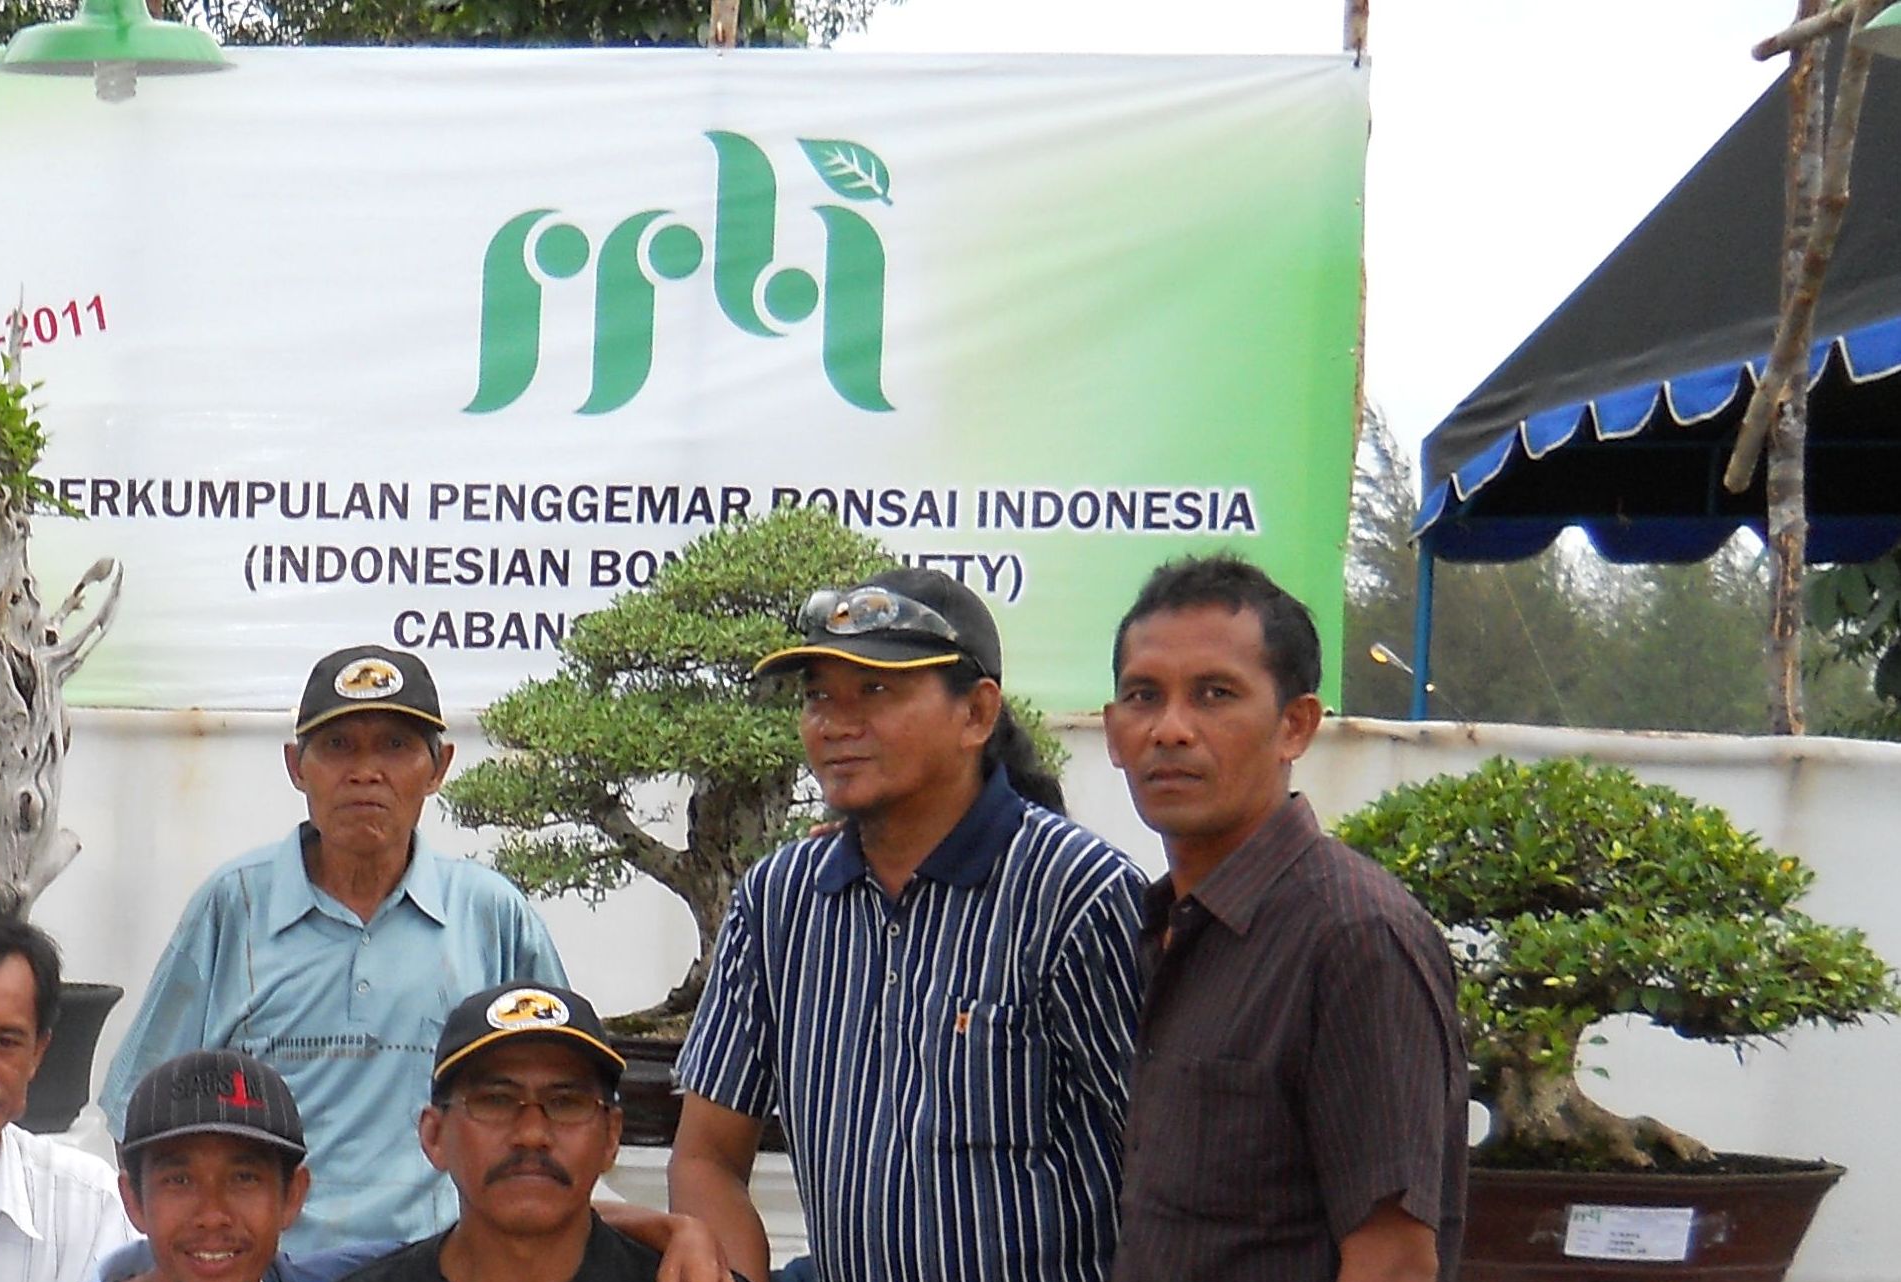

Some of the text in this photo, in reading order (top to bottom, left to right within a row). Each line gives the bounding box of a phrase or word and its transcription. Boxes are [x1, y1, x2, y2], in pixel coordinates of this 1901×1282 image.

[27, 478, 409, 520] PERKUMPULAN
[429, 482, 752, 525] PENGGEMAR
[978, 490, 1256, 531] INDONESIA
[244, 545, 570, 591] (INDONESIAN
[393, 610, 588, 650] CABAN
